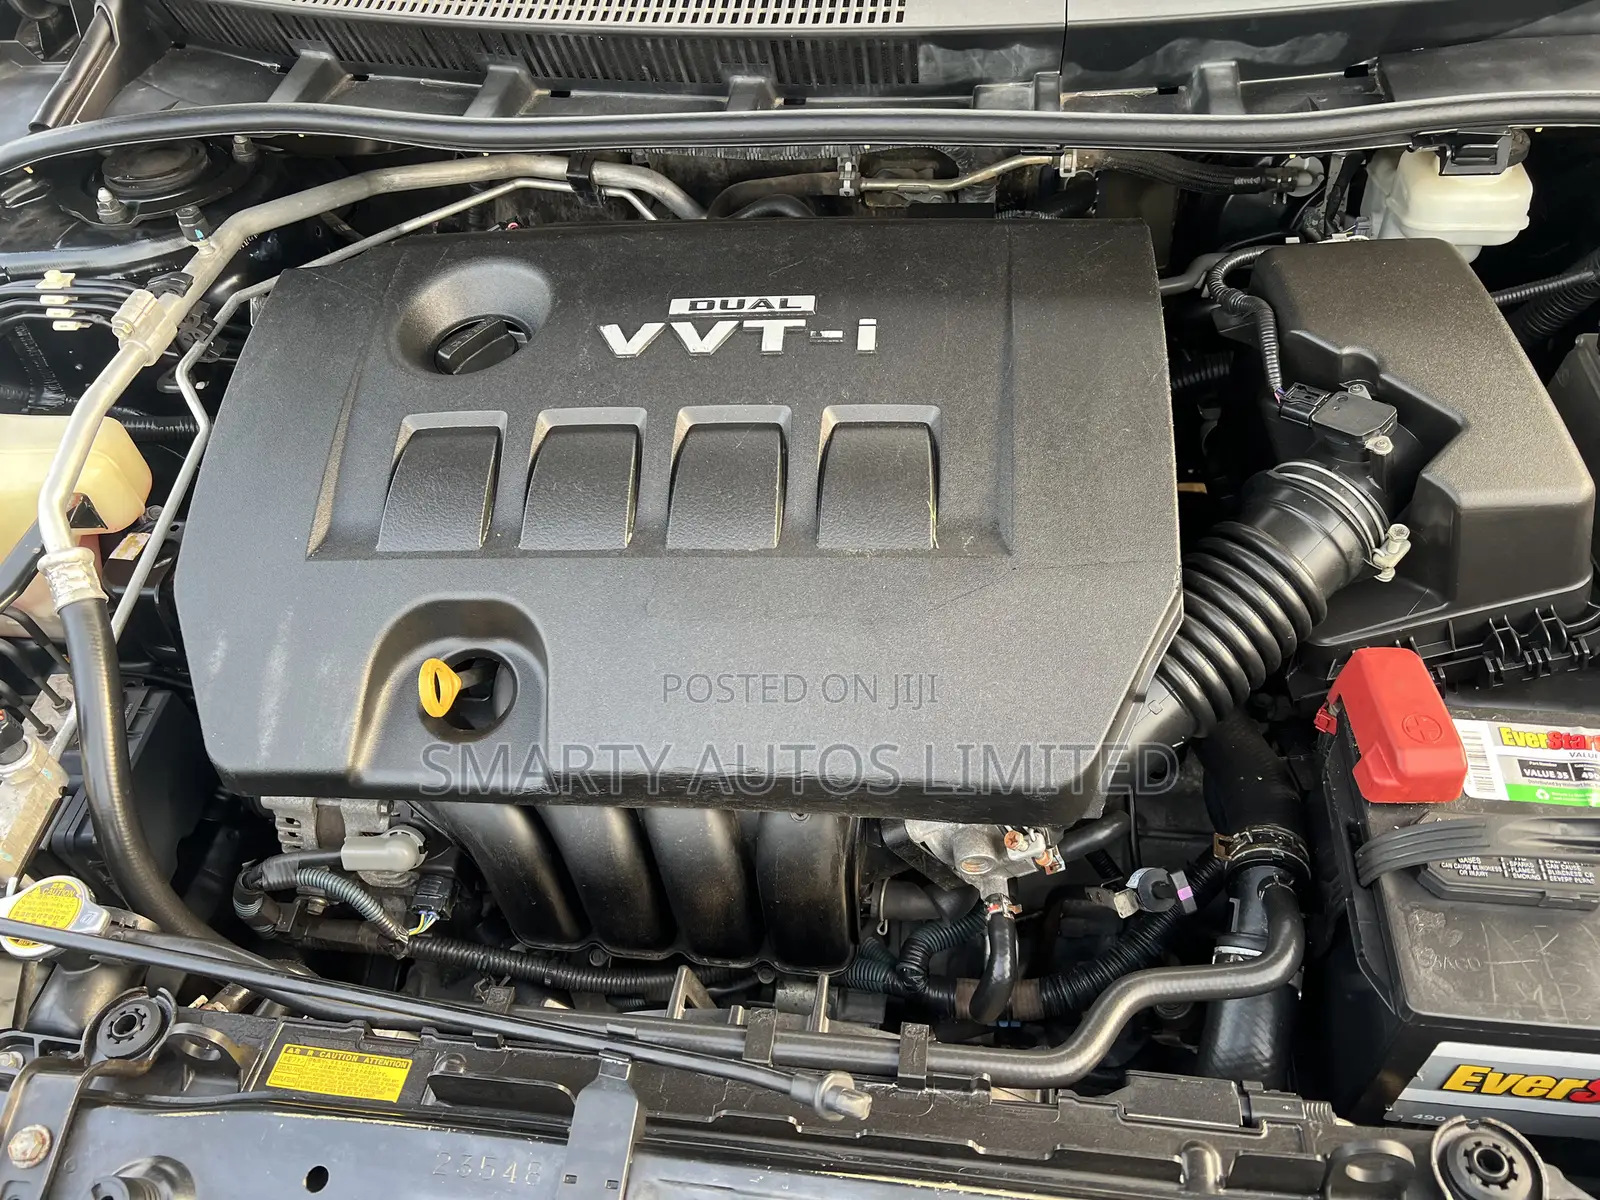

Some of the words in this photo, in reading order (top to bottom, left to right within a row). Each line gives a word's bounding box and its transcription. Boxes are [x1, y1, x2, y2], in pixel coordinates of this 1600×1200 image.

[688, 297, 803, 312] DUAL
[596, 317, 878, 358] VVT-i
[1523, 768, 1556, 778] VALUE
[1557, 771, 1569, 779] 35
[43, 888, 75, 896] CAUTION
[319, 1051, 359, 1063] CAUTION
[363, 1057, 408, 1069] ATTENTION
[1412, 1113, 1446, 1122] 490
[432, 1152, 542, 1186] 23548
